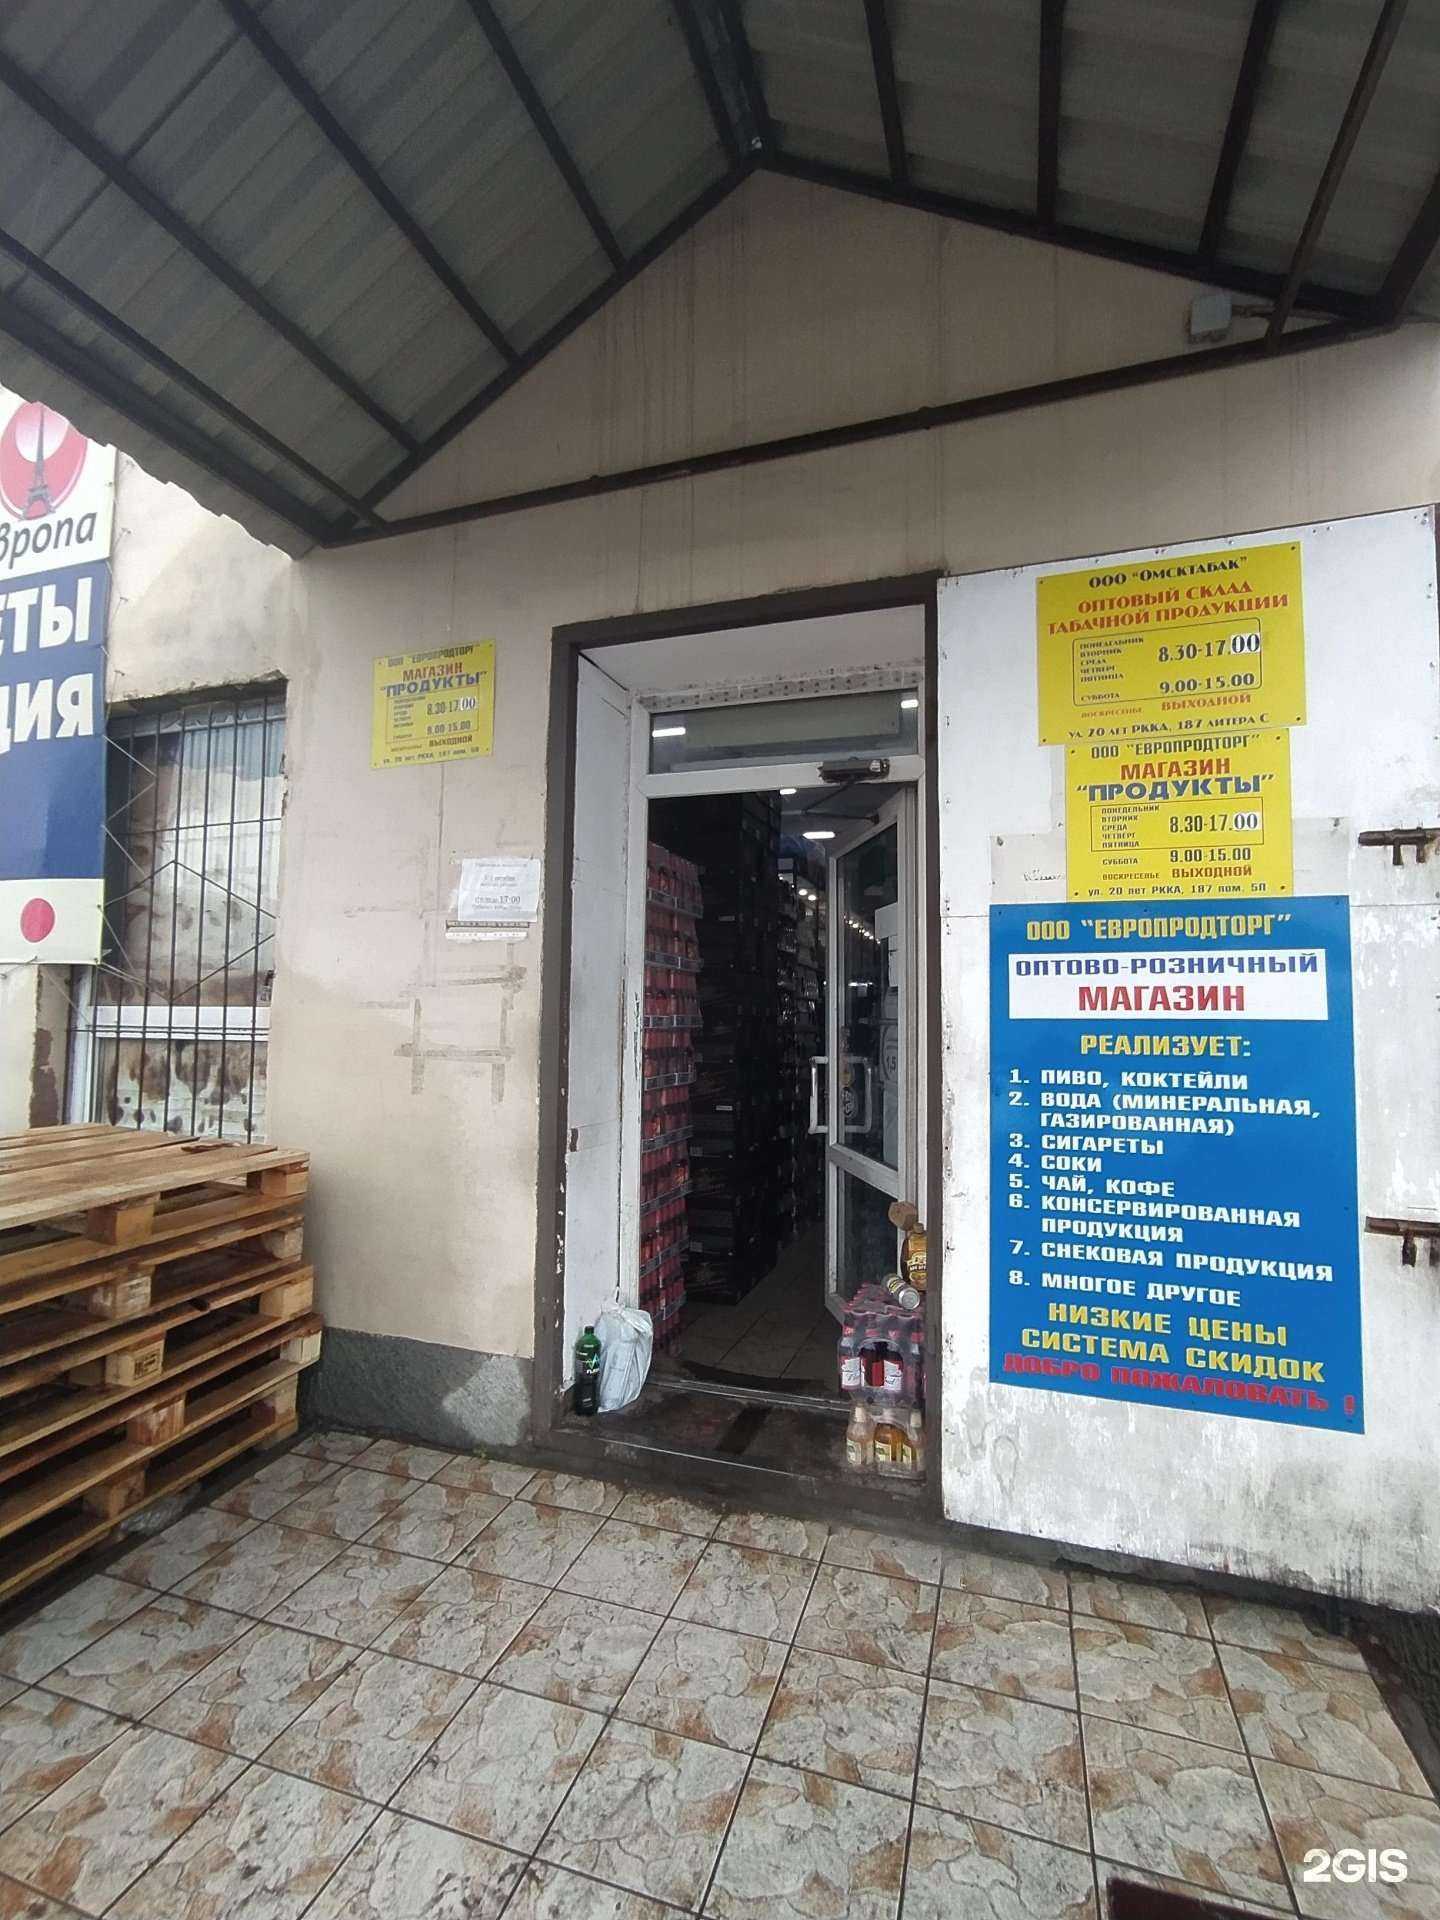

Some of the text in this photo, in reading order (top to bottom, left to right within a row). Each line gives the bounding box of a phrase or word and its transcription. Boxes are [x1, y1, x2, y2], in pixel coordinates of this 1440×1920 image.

[1089, 573, 1126, 588] ООО
[1078, 581, 1253, 614] ОПТОВЫЙ СКЛАД
[0, 577, 92, 655] ТЫ
[1048, 594, 1288, 635] ТАБАЧНОЙ ПРОДУКЦИИ
[1158, 634, 1260, 662] 8.30-17.00
[402, 662, 463, 681] МАГАЗИН
[1160, 673, 1255, 694] 9.00-15.00
[0, 673, 93, 755] ИЯ
[1161, 694, 1251, 711] ВЫХОДНОЙ
[1178, 719, 1203, 730] 187
[1207, 715, 1255, 727] ЛИТЕРА
[1260, 713, 1270, 723] С
[1091, 734, 1260, 759] ООО "ЕВРОПРОДТОРГ"
[1120, 757, 1231, 781] МАГАЗИН
[1076, 774, 1275, 802] "ПРОДУКТЫ"
[1170, 813, 1258, 833] 8.30-17.00
[1170, 847, 1251, 863] 9.00-15.00
[1172, 864, 1252, 878] ВЫХОДНОЙ
[1191, 884, 1212, 894] 187
[1026, 913, 1291, 941] ООО "ЕВРОПРОДТОРГ"
[1015, 953, 1318, 976] ОПТОВО-РОЗНИЧНЫЙ
[1078, 985, 1245, 1012] МАГАЗИН
[1080, 1034, 1251, 1057] РЕАЛИЗУЕТ:
[1009, 1069, 1248, 1090] 1. ПИВО, КОКТЕЙЛИ
[1009, 1091, 1321, 1119] 2. ВОДА (МИНЕРАЛЬНАЯ,
[1040, 1112, 1234, 1136] ГАЗИРОВАННАЯ)
[1009, 1133, 1164, 1155] 3. СИГАРЕТЫ
[1008, 1153, 1103, 1173] 4. СОКИ
[1008, 1173, 1175, 1198] 5. ЧАЙ, КОФЕ
[1008, 1193, 1301, 1229] 6. КОНСЕРВИРОВАННАЯ
[1041, 1217, 1184, 1243] ПРОДУКЦИЯ
[1008, 1239, 1333, 1283] 7. СНЕКОВАЯ ПРОДУКЦИЯ
[1008, 1270, 1241, 1307] 8. МНОГОЕ ДРУГОЕ
[1049, 1302, 1287, 1347] НИЗКИЕ ЦЕНЫ
[1021, 1328, 1325, 1383] СИСТЕМА СКИДОК
[1003, 1352, 1101, 1381] ДОБРО
[1111, 1365, 1328, 1412] ПОЖАЛОВАТЬ
